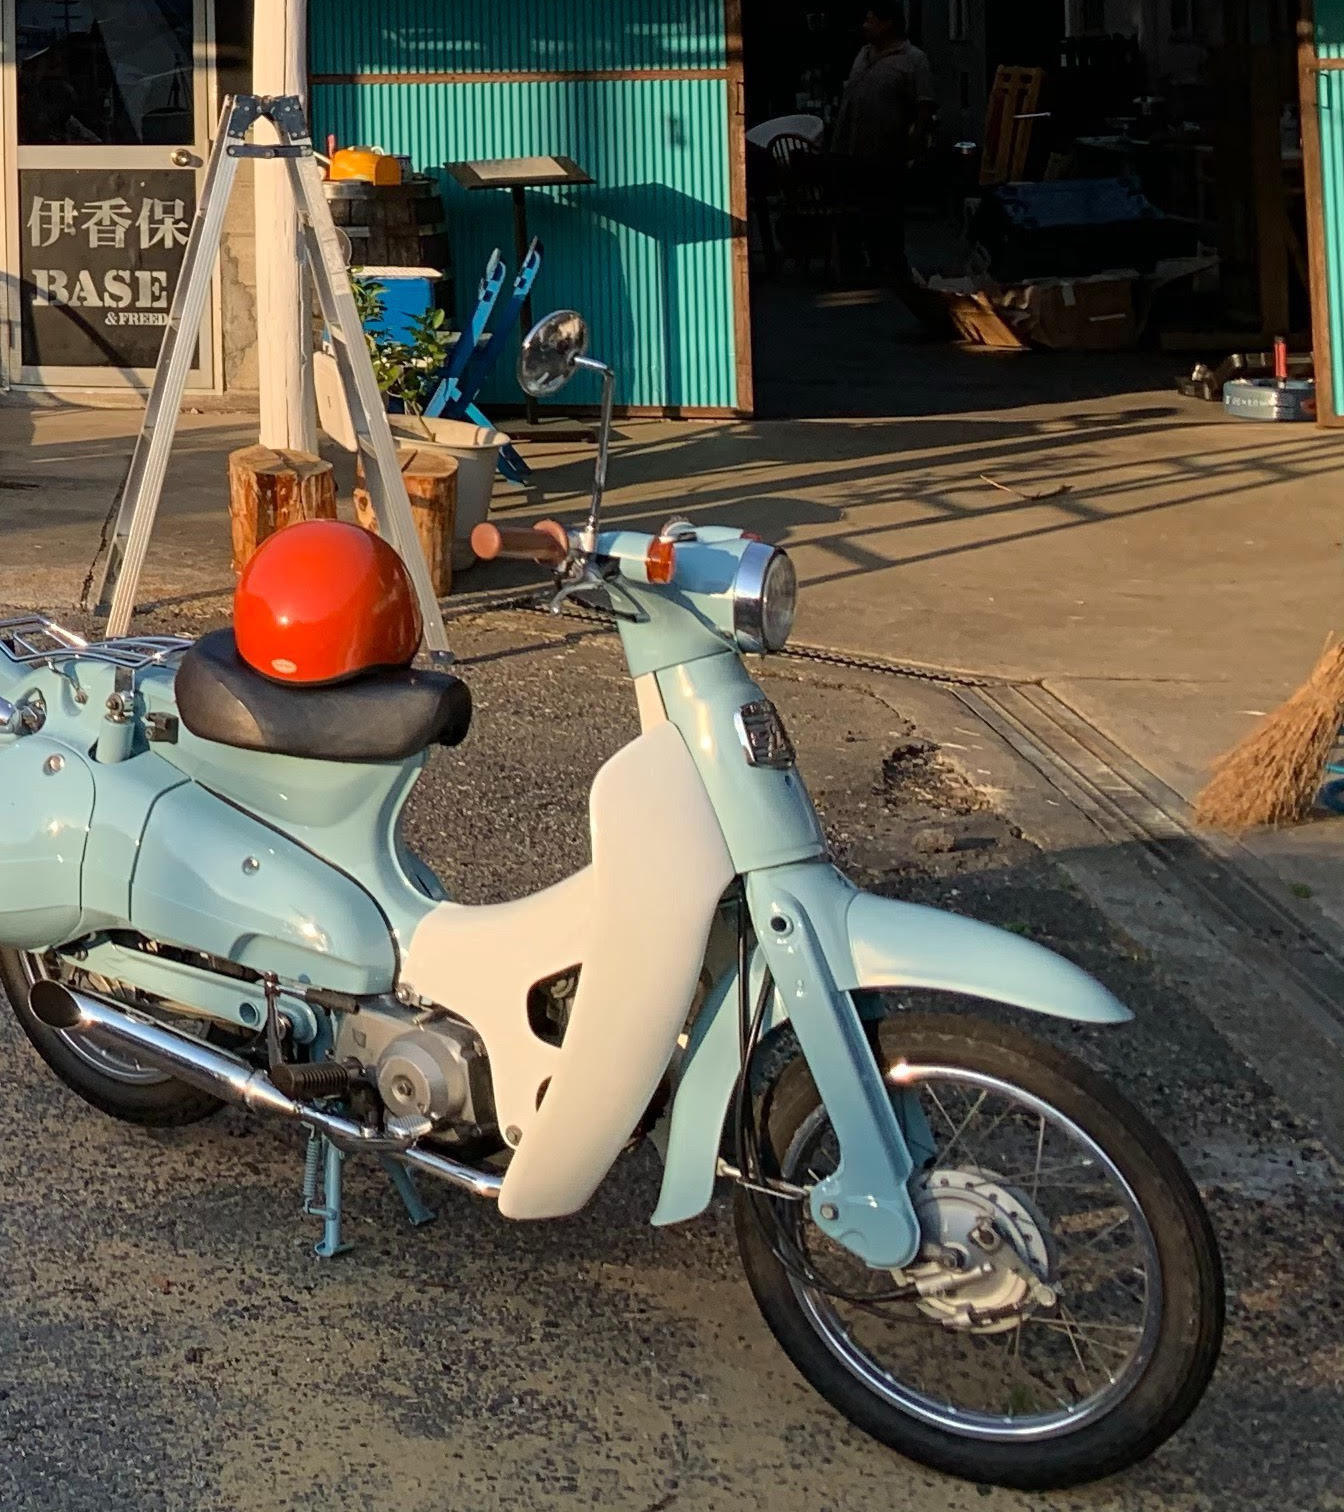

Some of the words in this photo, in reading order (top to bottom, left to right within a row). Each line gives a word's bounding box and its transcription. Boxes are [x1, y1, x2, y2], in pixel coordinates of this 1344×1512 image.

[26, 195, 190, 249] 伊香保
[31, 269, 168, 308] BASE
